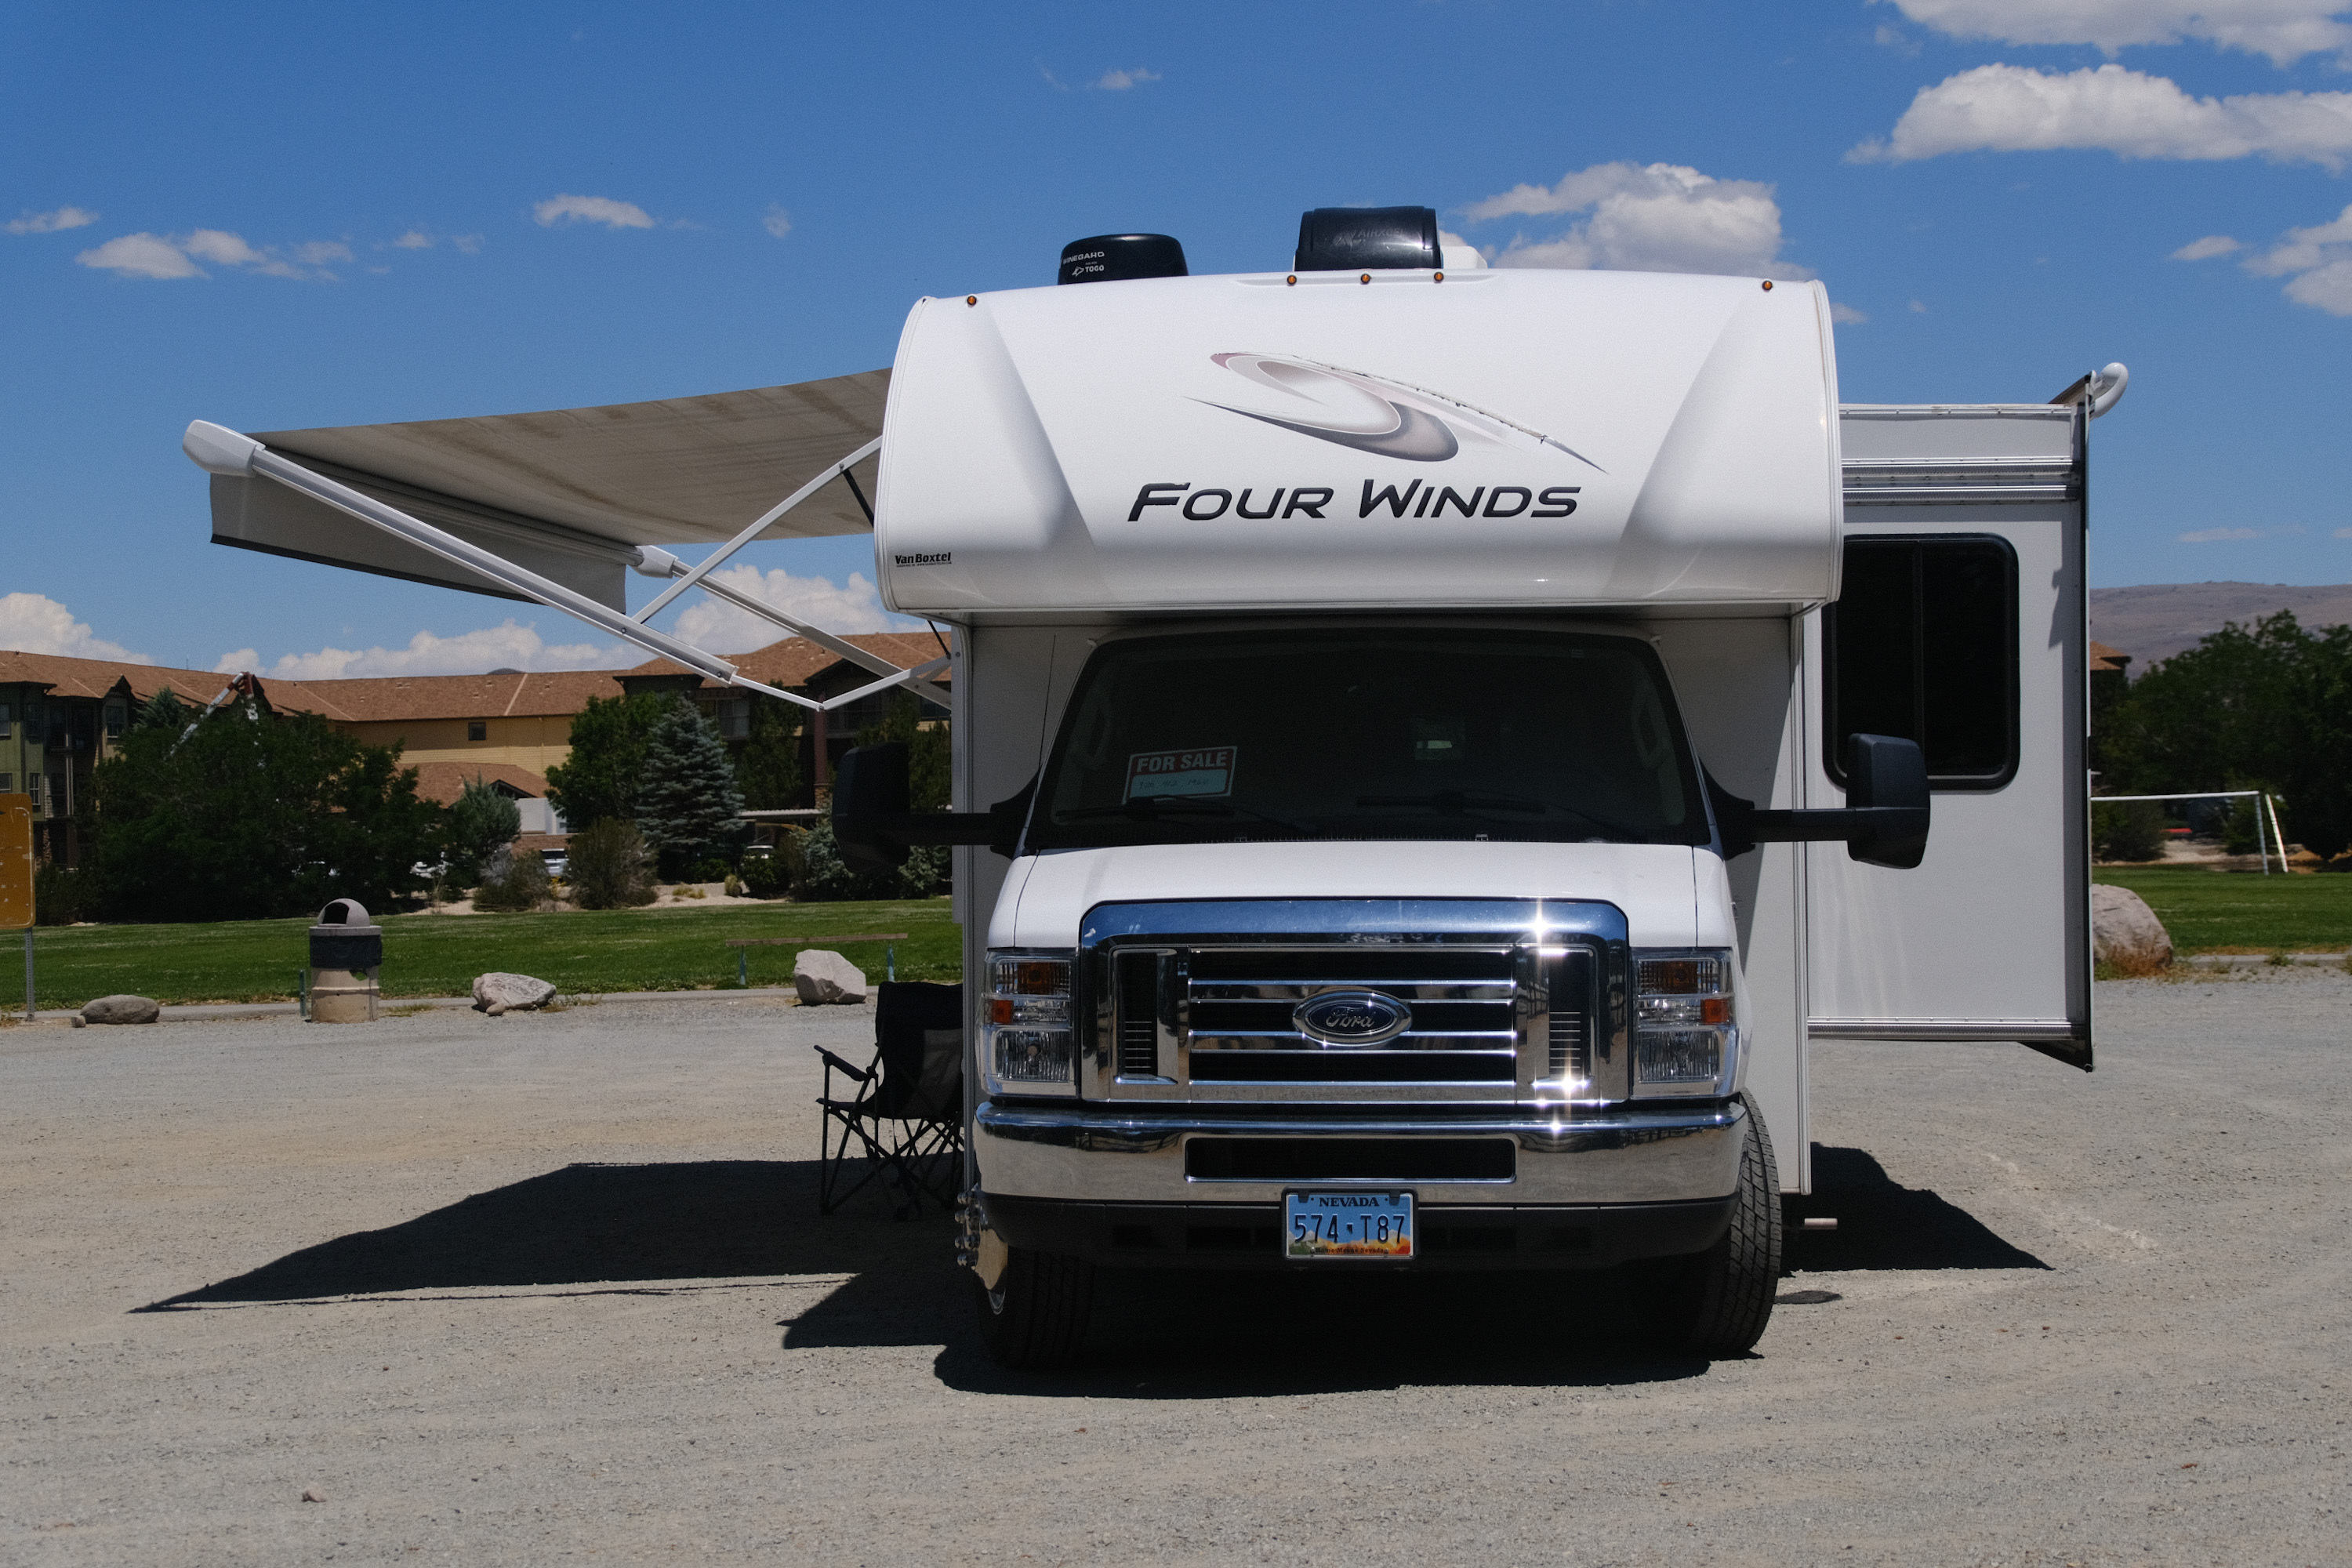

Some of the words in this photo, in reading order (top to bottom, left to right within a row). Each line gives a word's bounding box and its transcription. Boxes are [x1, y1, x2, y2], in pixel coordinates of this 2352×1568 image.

[1085, 264, 1105, 273] TOGO
[1127, 482, 1334, 521] FOUR
[1359, 478, 1582, 519] WINDS
[1136, 755, 1175, 772] FOR
[1180, 751, 1228, 769] SALE
[1326, 1006, 1377, 1028] Ford
[1319, 1196, 1380, 1207] NEVADA
